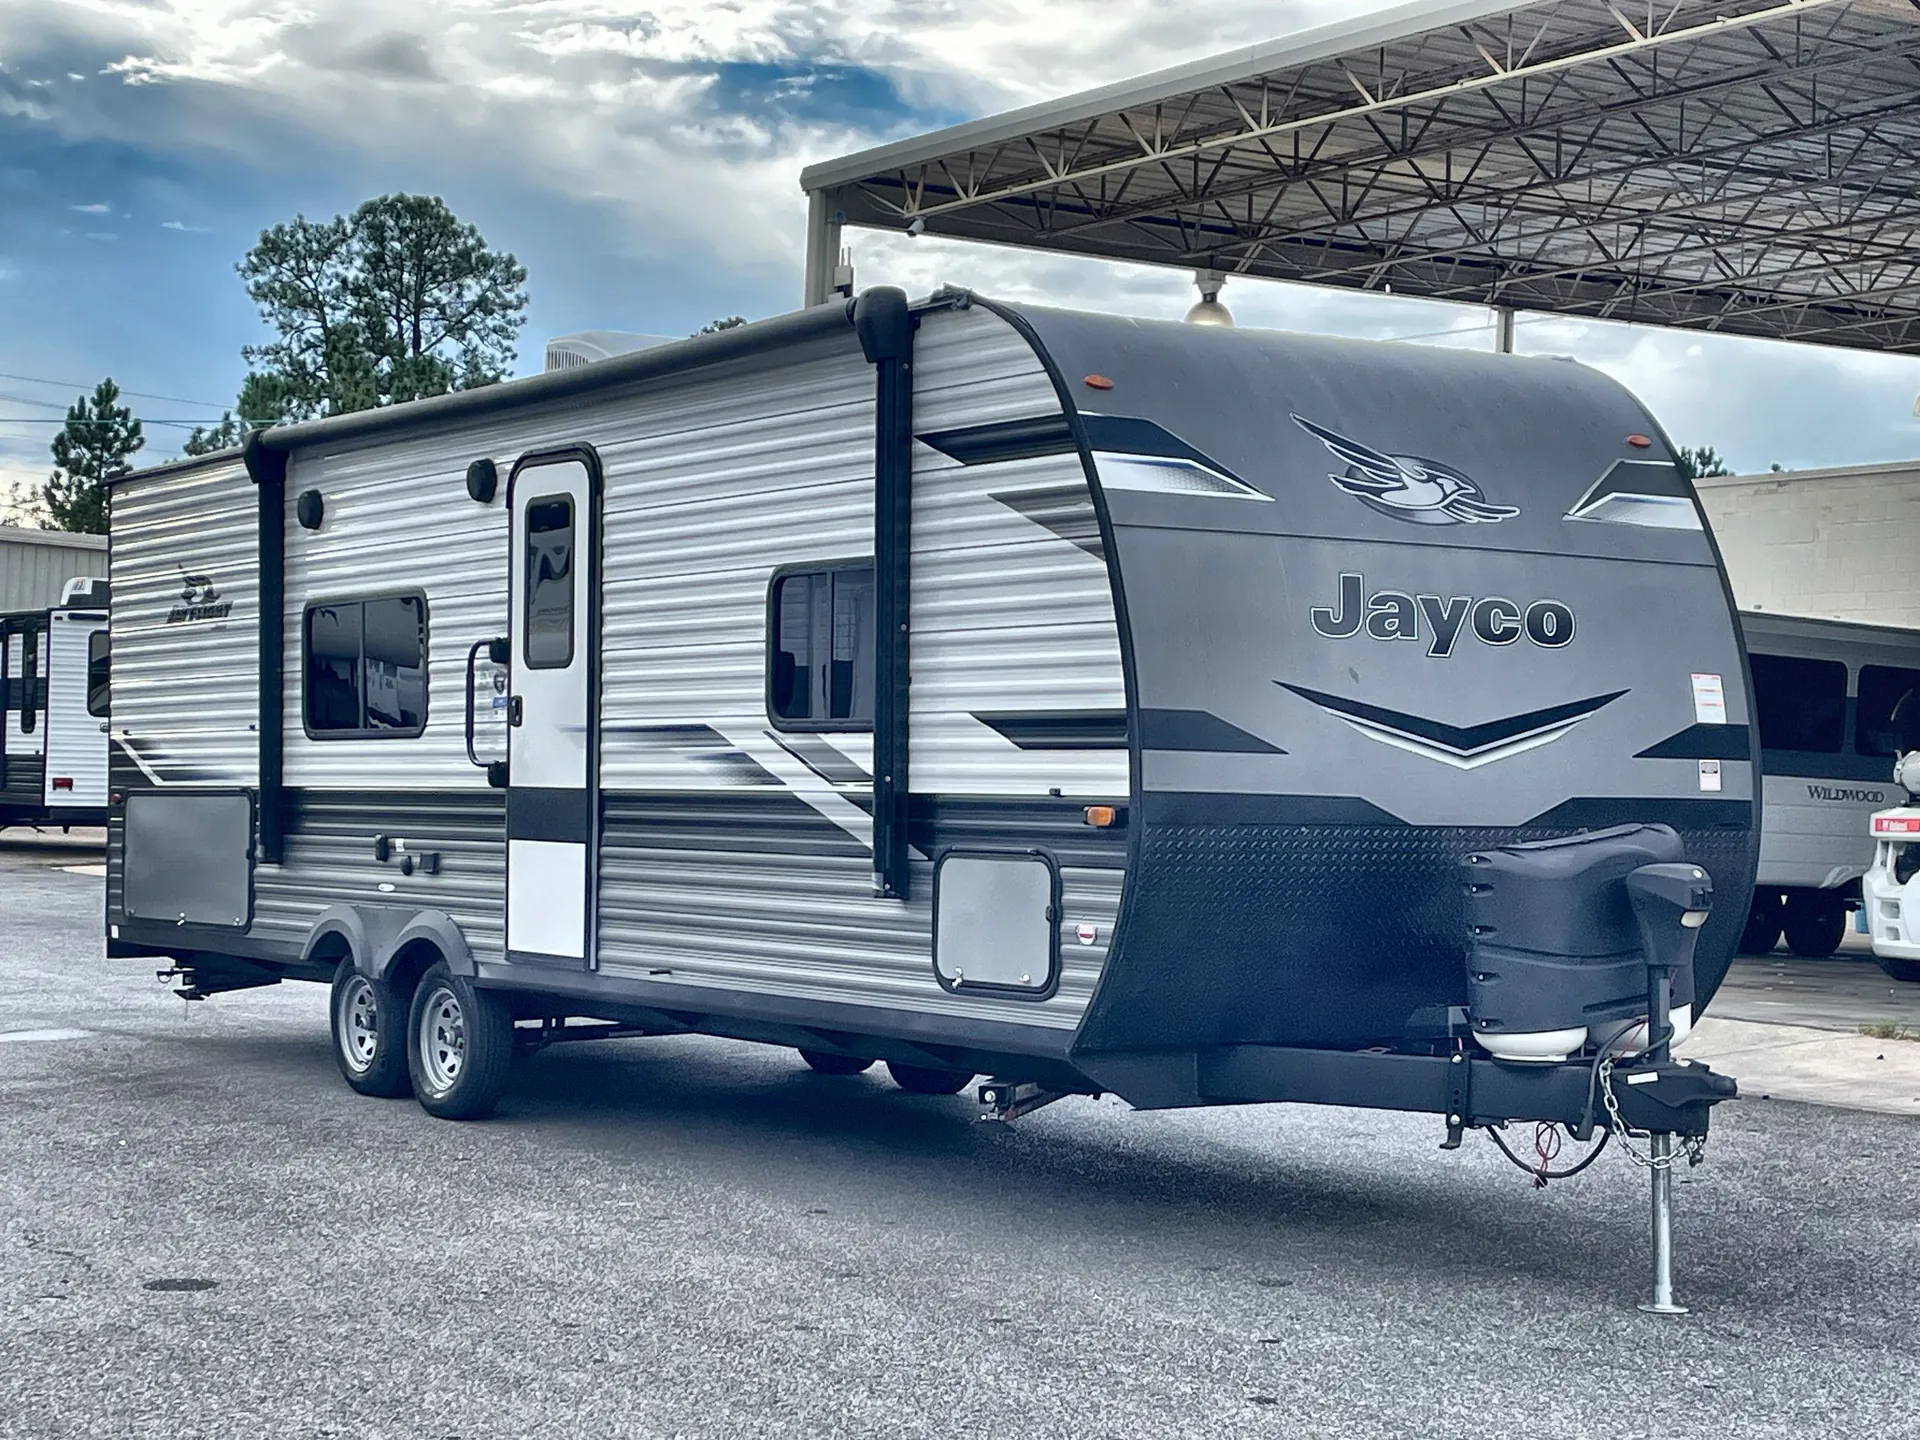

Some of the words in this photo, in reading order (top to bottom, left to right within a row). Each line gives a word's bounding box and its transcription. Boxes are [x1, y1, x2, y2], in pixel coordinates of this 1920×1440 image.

[189, 601, 233, 620] FLIGHT
[1310, 572, 1576, 658] Jayco
[1807, 785, 1885, 803] WILDWOOD
